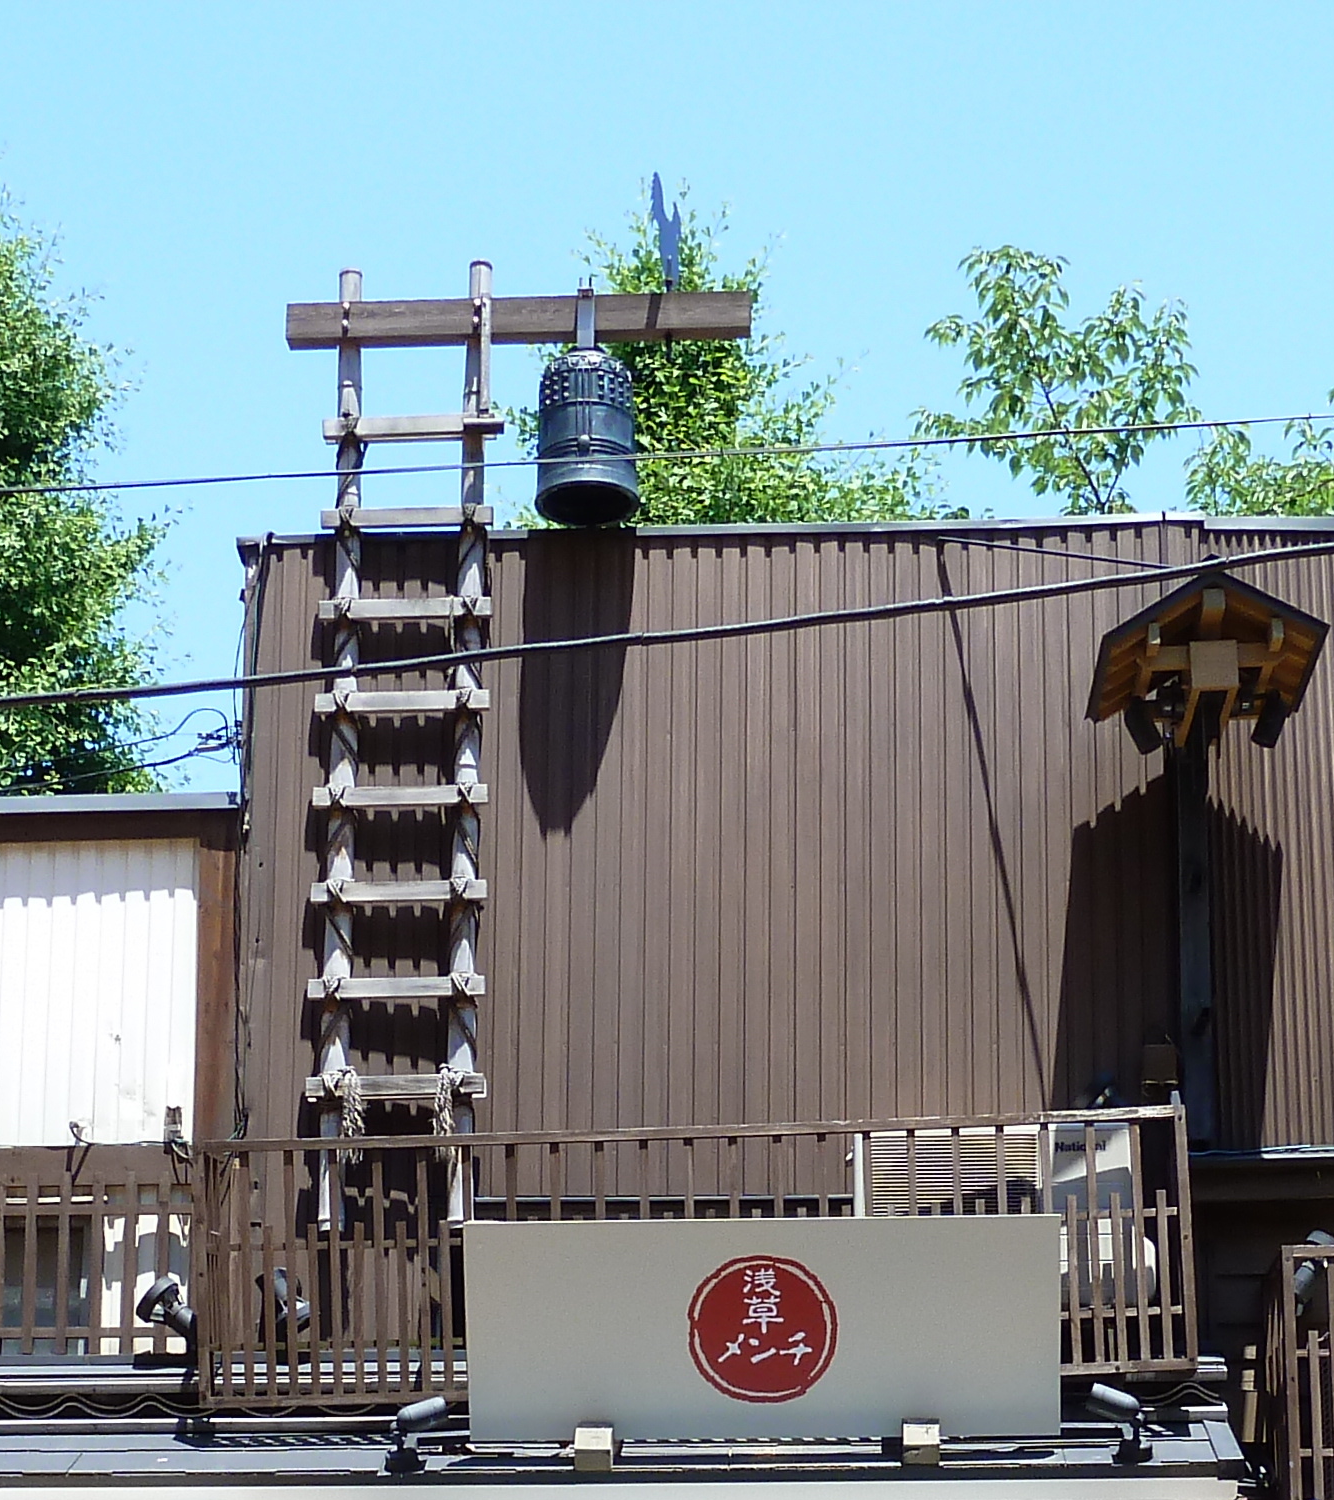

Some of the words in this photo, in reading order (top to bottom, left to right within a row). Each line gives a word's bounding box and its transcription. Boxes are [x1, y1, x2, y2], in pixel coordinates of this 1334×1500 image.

[1054, 1140, 1107, 1153] Natioal
[742, 1268, 784, 1334] 浅草
[717, 1331, 813, 1365] メンチ
